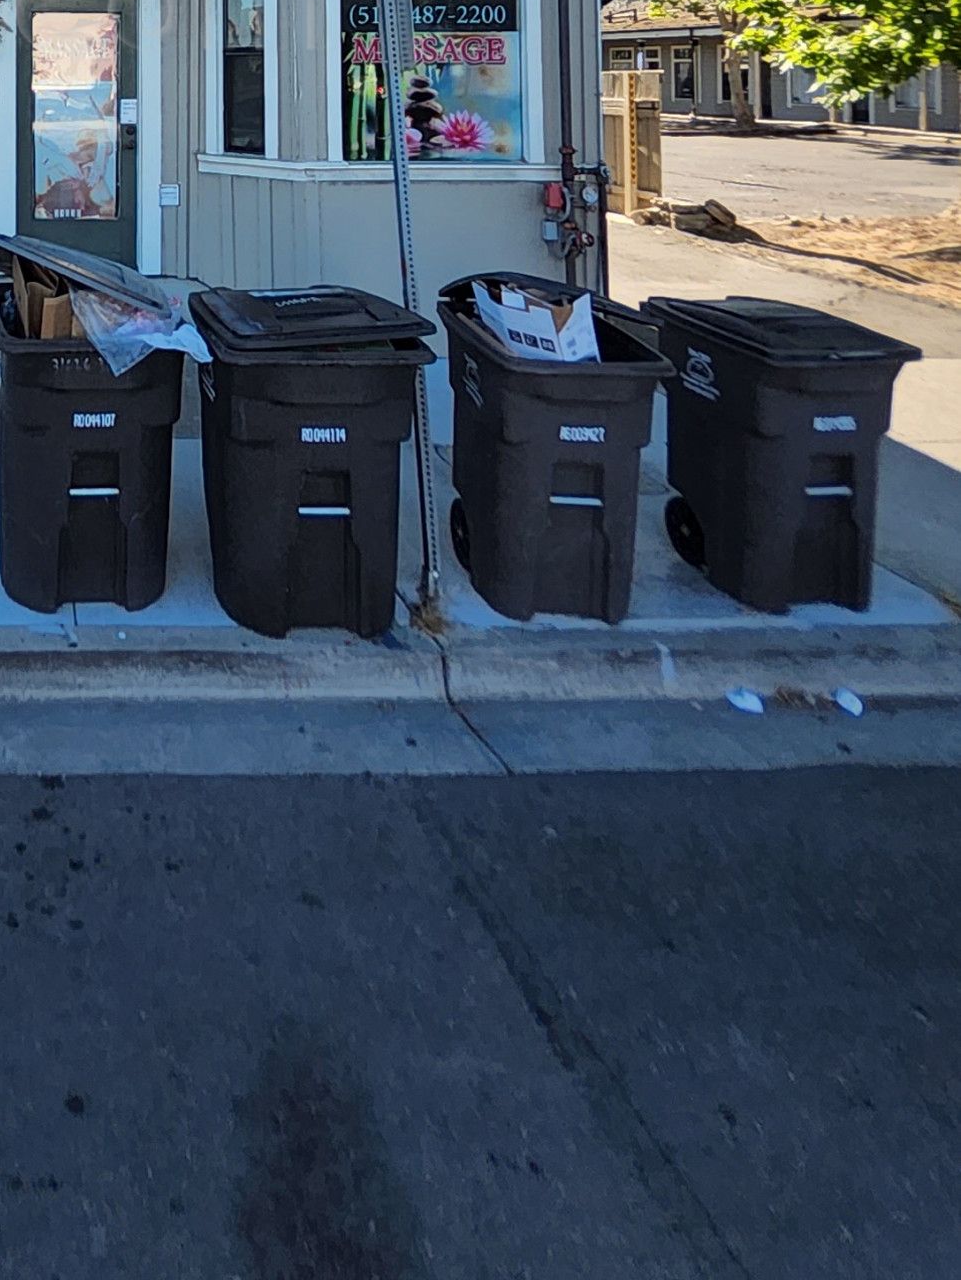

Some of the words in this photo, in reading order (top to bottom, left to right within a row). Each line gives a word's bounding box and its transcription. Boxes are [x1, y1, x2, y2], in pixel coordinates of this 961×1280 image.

[349, 4, 379, 28] (51
[411, 4, 506, 24] 487-2200
[352, 36, 507, 65] MSAGE
